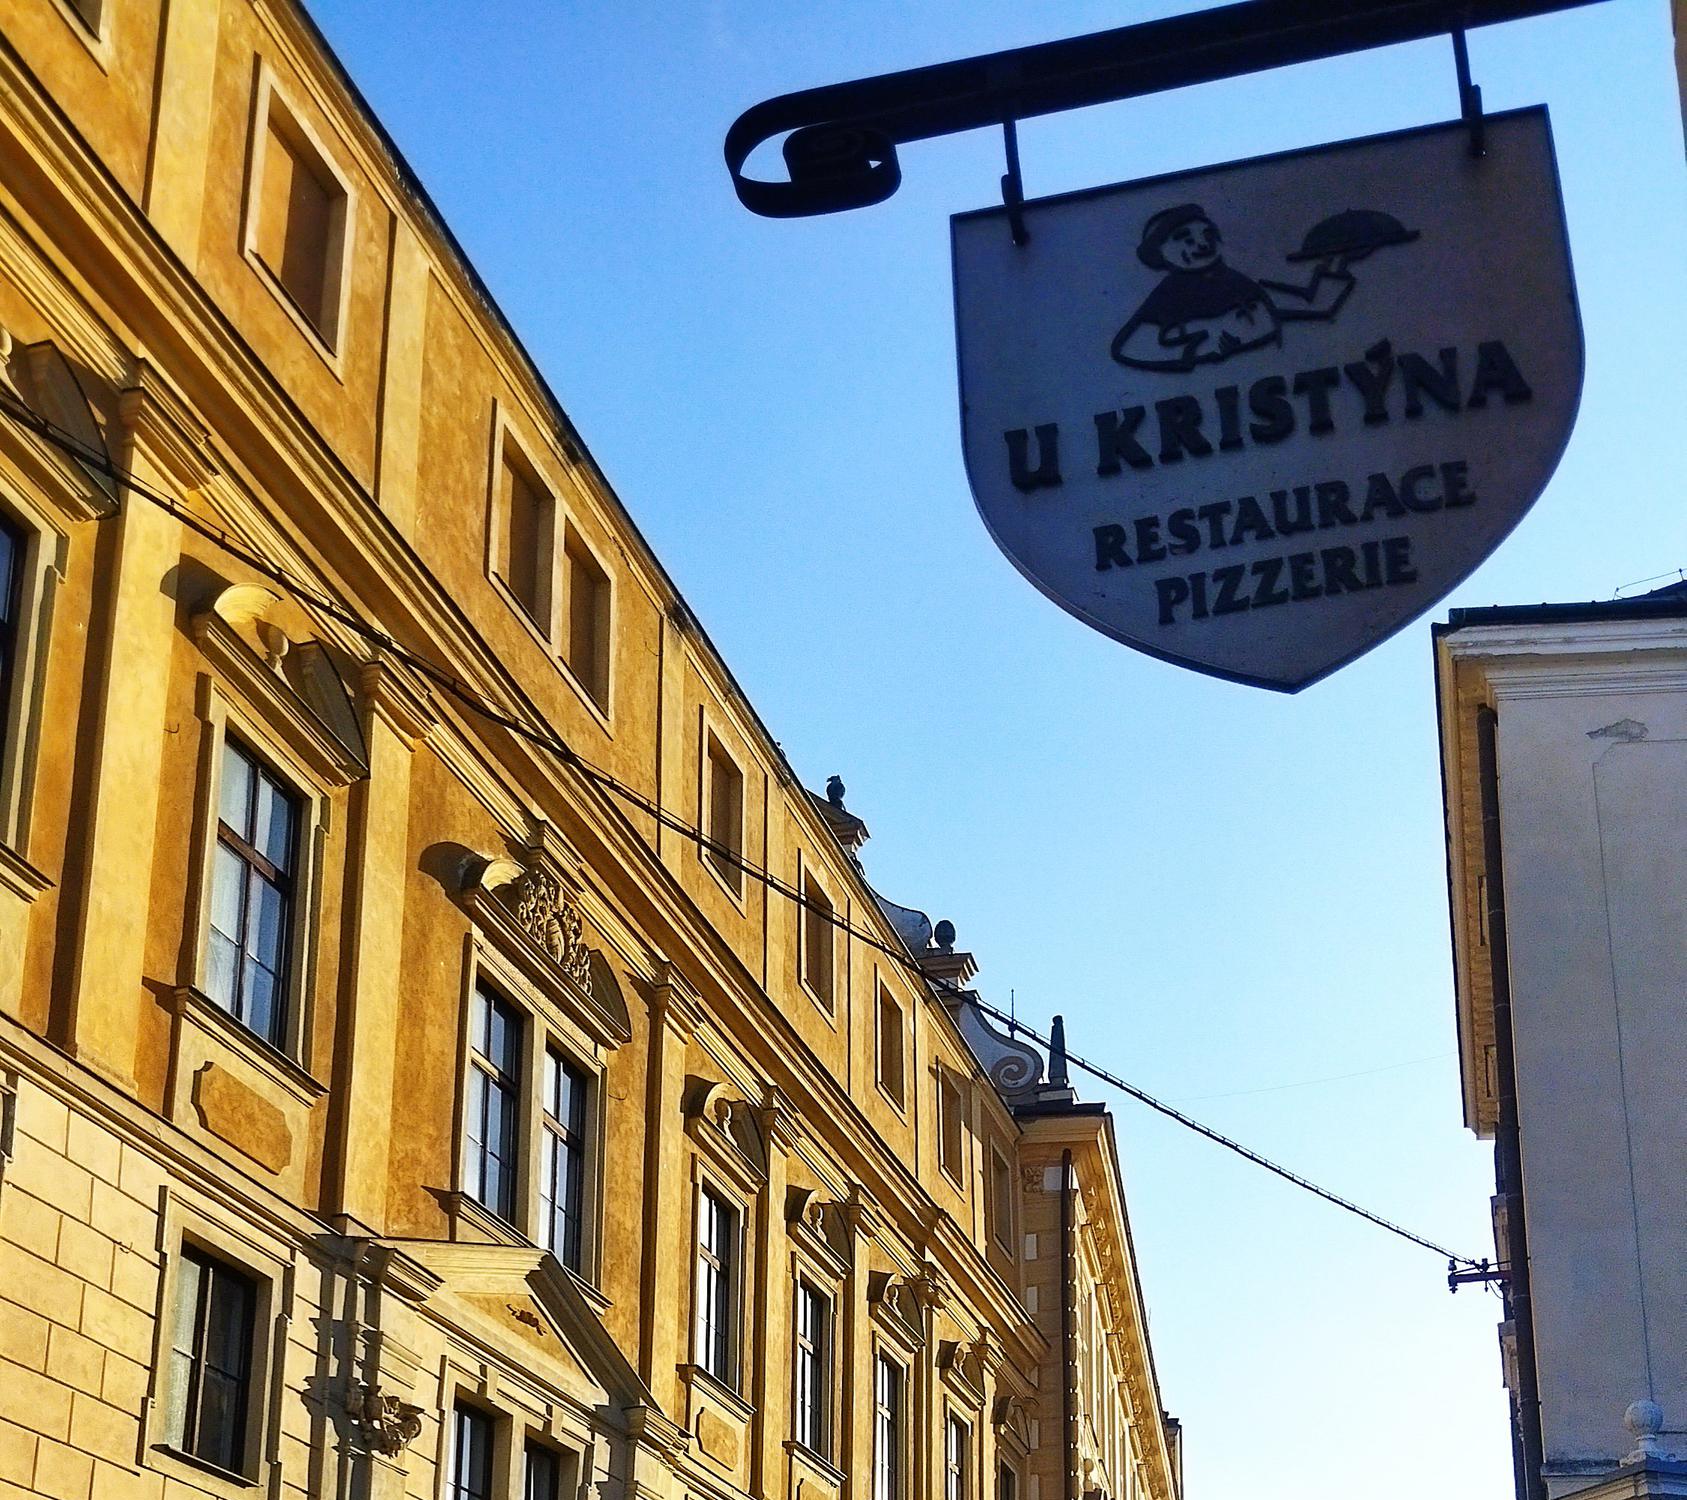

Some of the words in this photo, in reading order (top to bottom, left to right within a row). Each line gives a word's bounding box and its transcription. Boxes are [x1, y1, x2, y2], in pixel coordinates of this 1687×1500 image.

[1003, 422, 1064, 495] U
[1094, 337, 1532, 476] KRISTÝNA
[1092, 460, 1478, 573] RESTAURACE
[1155, 536, 1420, 627] PIZZERIE
